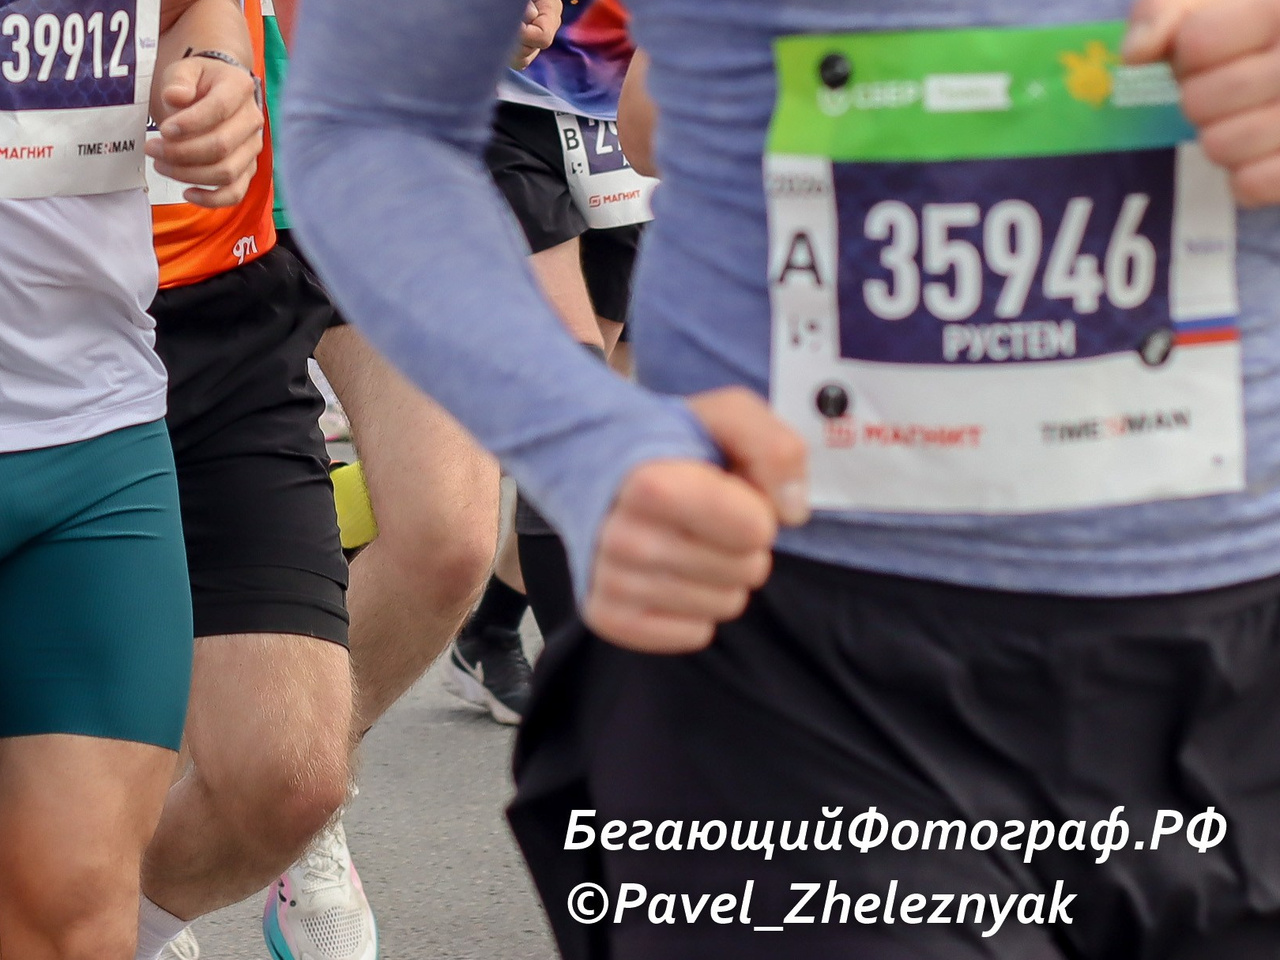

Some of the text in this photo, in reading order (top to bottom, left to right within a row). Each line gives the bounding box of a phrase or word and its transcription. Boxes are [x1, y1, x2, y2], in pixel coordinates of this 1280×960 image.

[1, 9, 130, 83] 39912
[603, 190, 641, 204] МАГНИТ
[862, 192, 1158, 321] 35946
[941, 319, 1077, 362] РУСТЕМ
[863, 423, 983, 449] МАГНИТ
